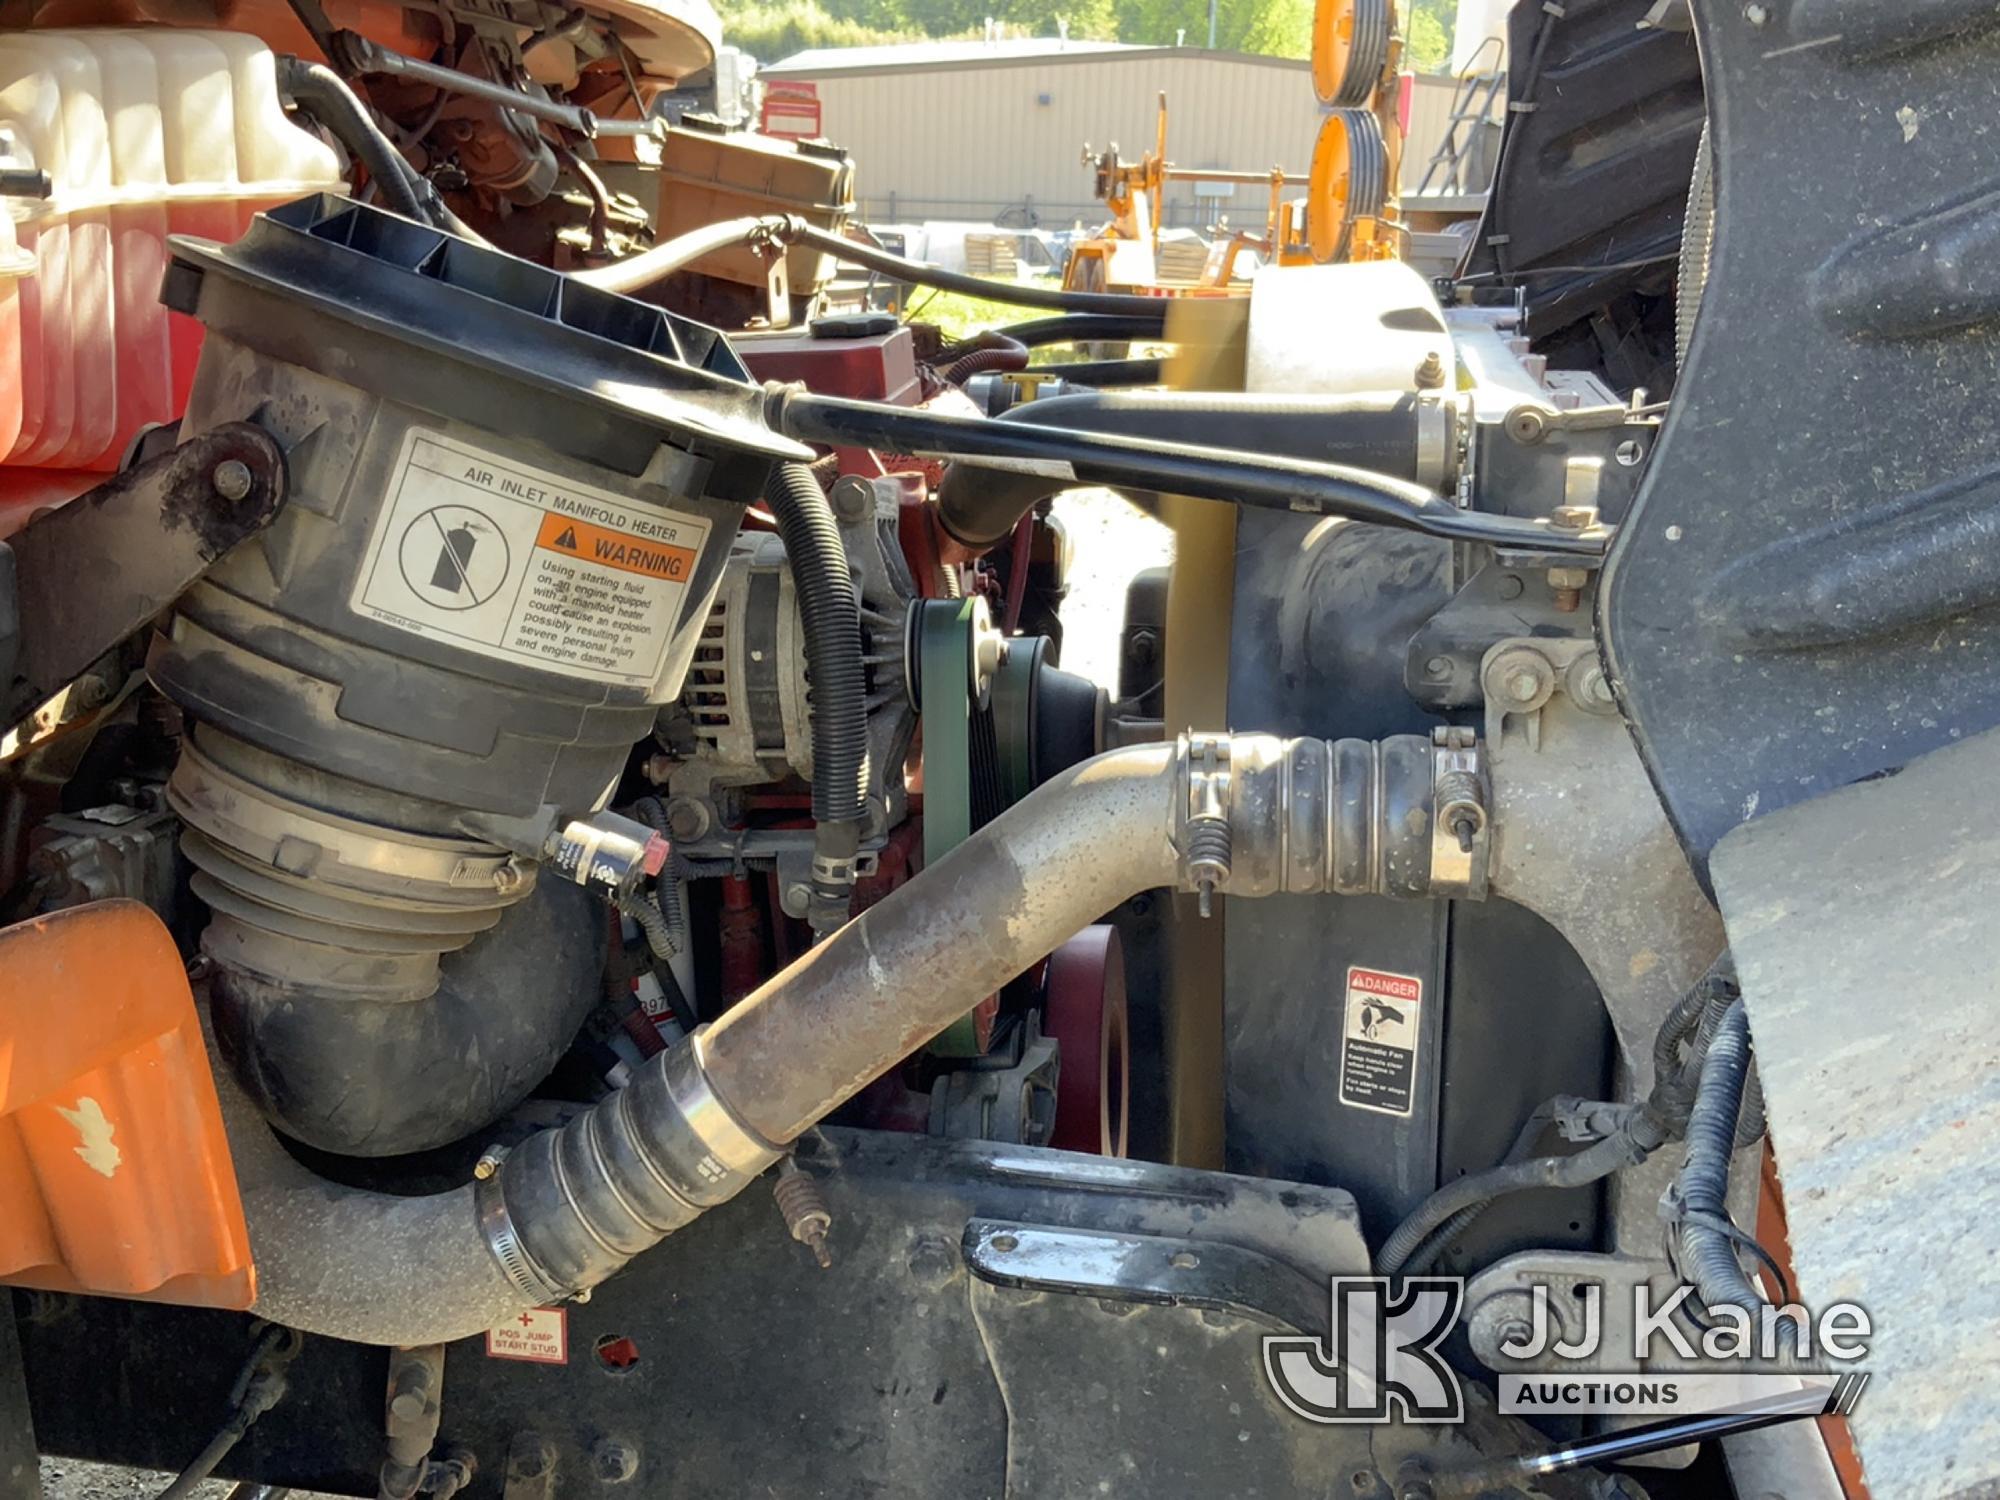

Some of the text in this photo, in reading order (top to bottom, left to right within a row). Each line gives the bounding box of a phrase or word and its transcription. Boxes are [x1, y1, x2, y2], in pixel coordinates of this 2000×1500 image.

[464, 467, 678, 541] AIR INLET MANIFOLD HEATER
[594, 538, 683, 574] WARNING
[537, 574, 552, 585] on
[574, 583, 608, 599] engine
[611, 594, 652, 609] equipped
[542, 560, 645, 595] Using starting fluid
[528, 600, 560, 614] could
[533, 587, 556, 600] with
[571, 598, 615, 614] manifold
[617, 607, 644, 620] heater
[520, 625, 635, 660] severe personal injury
[524, 612, 572, 634] possibly
[576, 625, 620, 645] resulting
[515, 638, 538, 650] and
[541, 644, 577, 660] engine
[1364, 977, 1417, 998] DANGER
[495, 1340, 559, 1354] START STUD
[499, 1329, 554, 1342] POS JUMP
